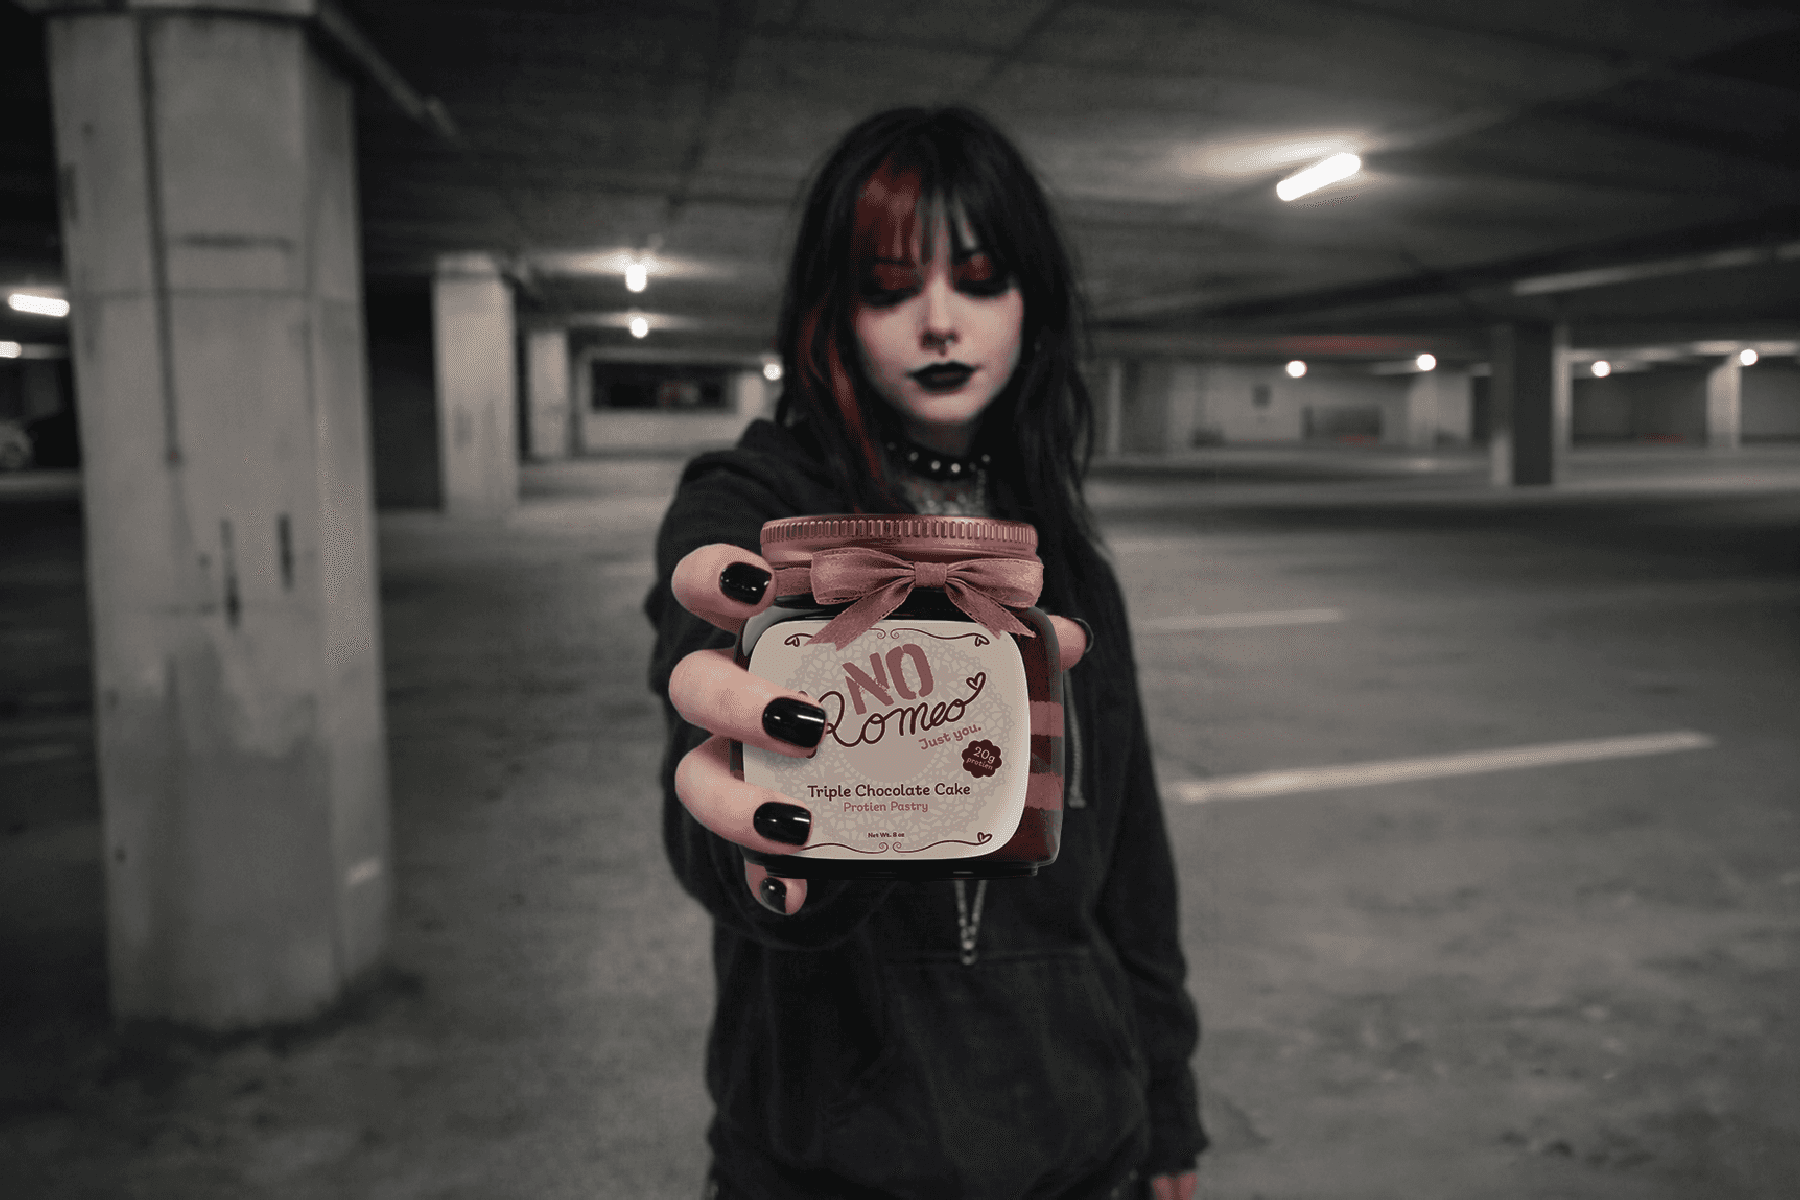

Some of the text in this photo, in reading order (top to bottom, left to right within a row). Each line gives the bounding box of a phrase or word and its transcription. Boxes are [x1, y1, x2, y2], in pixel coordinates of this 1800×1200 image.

[842, 643, 935, 716] NO
[918, 724, 982, 750] Just you.
[966, 757, 994, 771] protien
[972, 746, 996, 764] 20g
[807, 782, 971, 802] Triple Chocolate Cake
[844, 801, 929, 813] Protien Pastry
